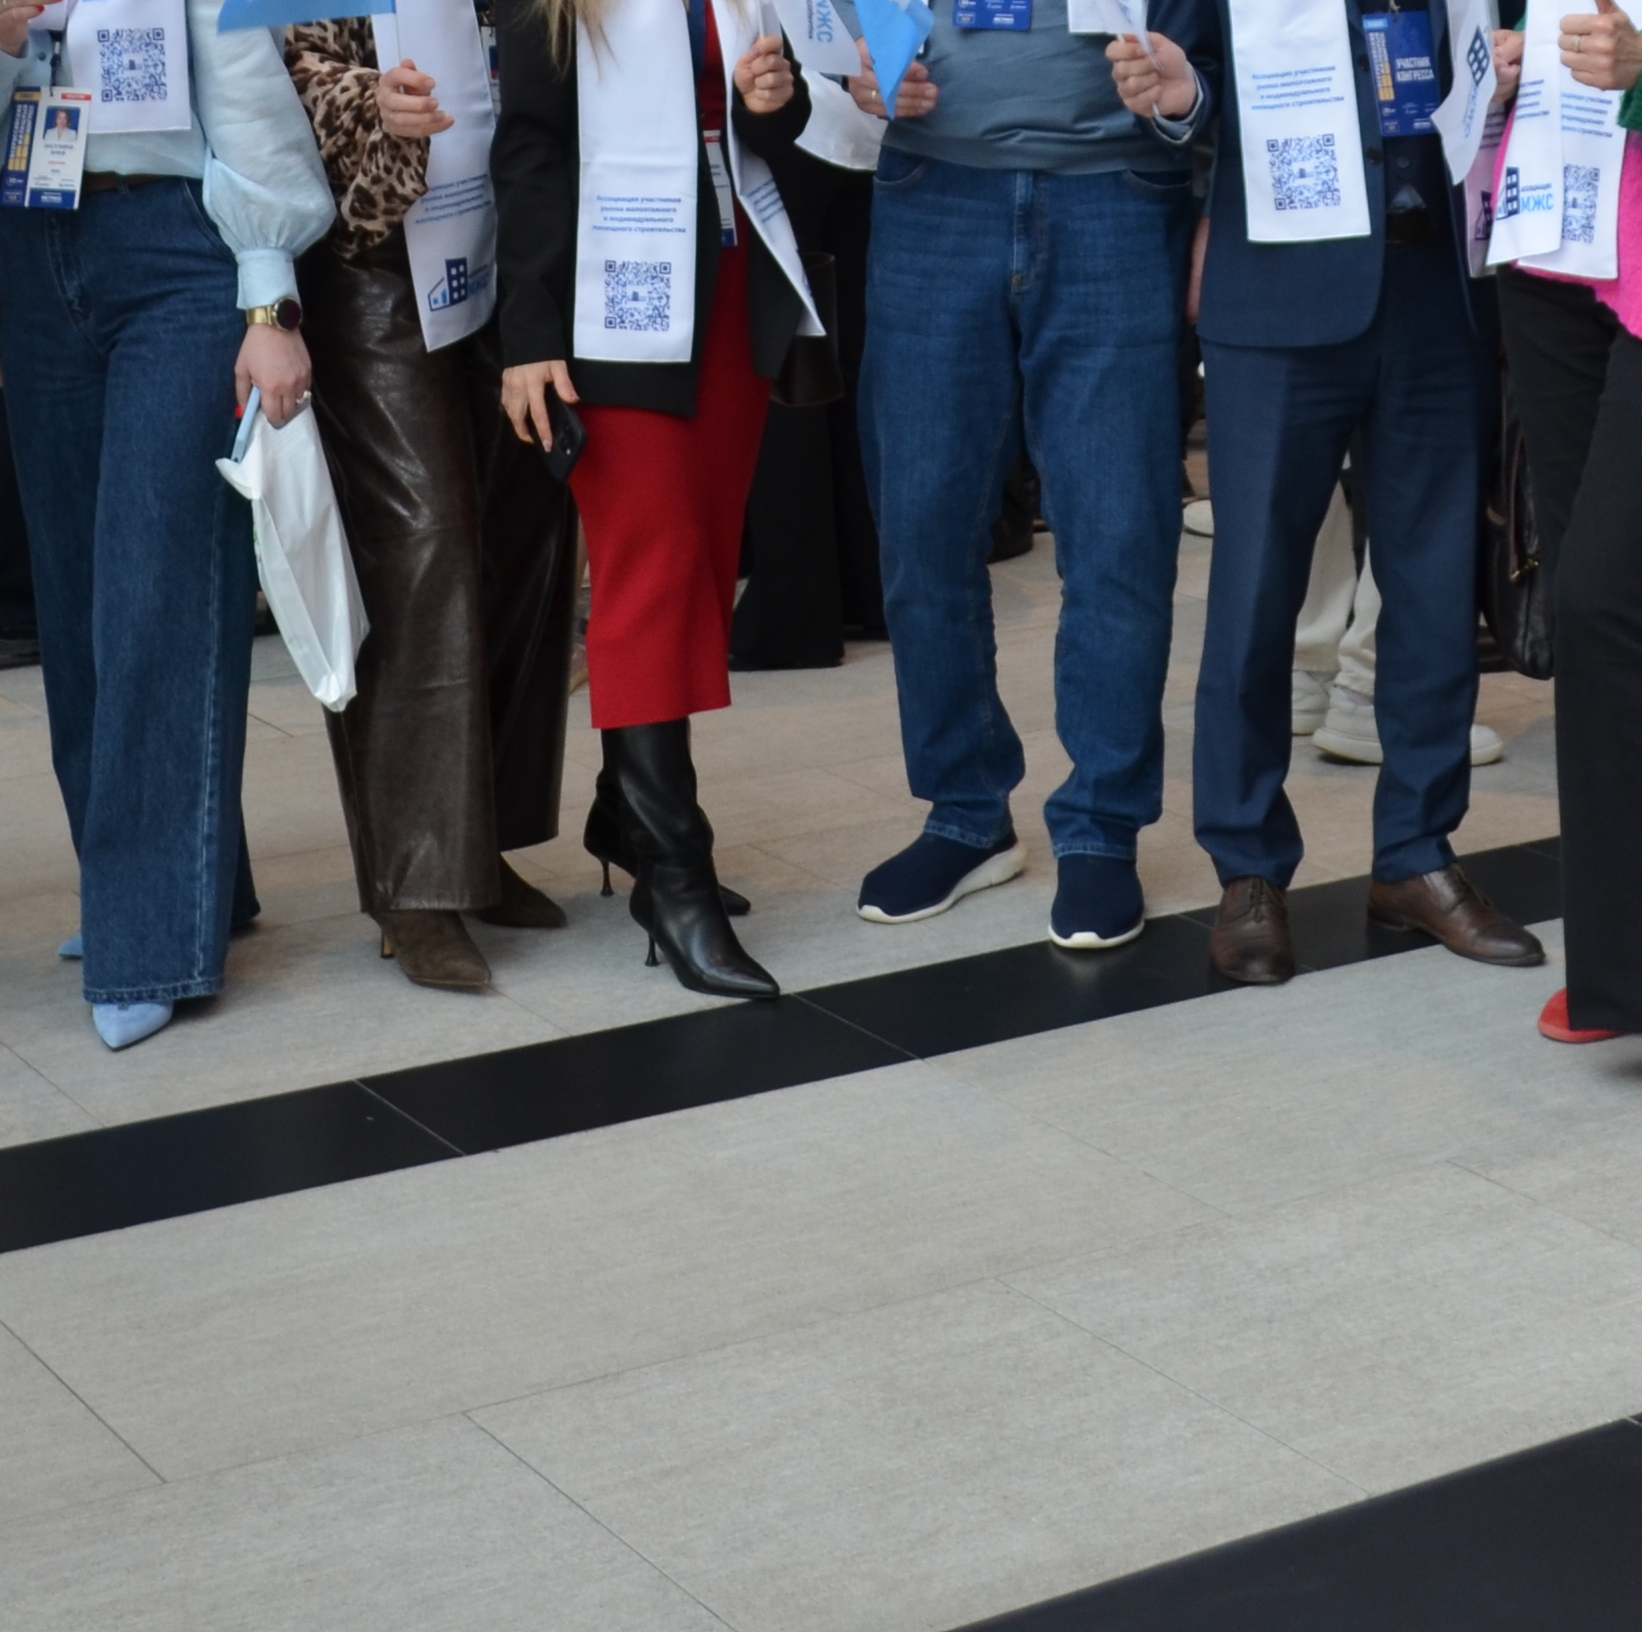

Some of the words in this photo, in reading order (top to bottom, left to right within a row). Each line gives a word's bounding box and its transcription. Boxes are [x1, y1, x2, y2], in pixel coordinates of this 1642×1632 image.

[1395, 56, 1432, 69] УЧАСТНИК
[1395, 70, 1435, 82] КОНГРЕССА
[1520, 193, 1555, 215] МЖС
